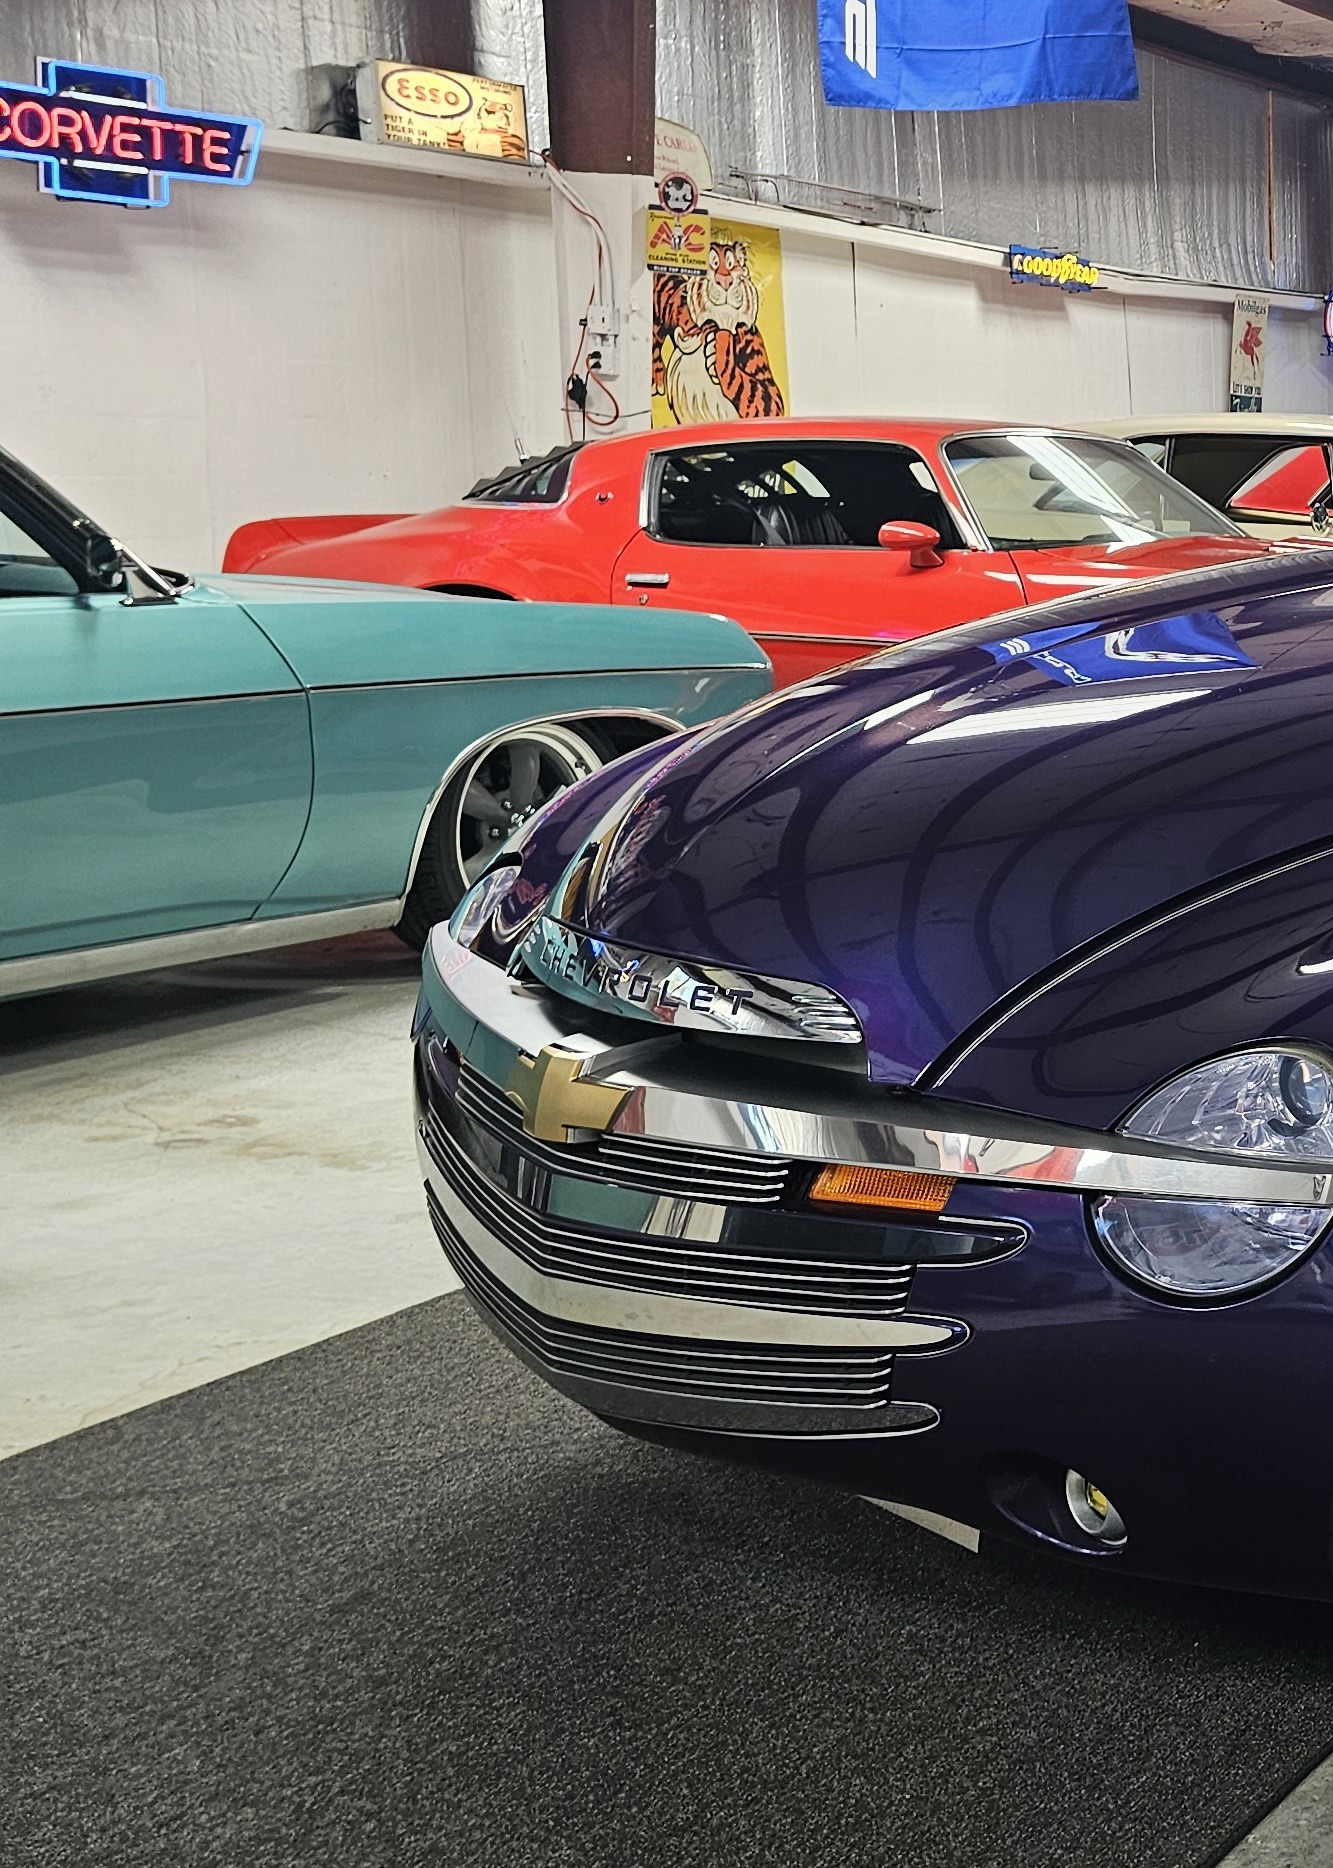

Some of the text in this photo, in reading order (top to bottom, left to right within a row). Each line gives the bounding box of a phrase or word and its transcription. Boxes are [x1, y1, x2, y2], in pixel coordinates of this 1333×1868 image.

[397, 78, 460, 106] ESSO
[385, 124, 415, 136] TIGER
[650, 221, 706, 253] AC
[1023, 254, 1100, 285] GOODYEAR
[1237, 299, 1267, 317] Mobilgas
[539, 938, 754, 1016] CHEVROLET
